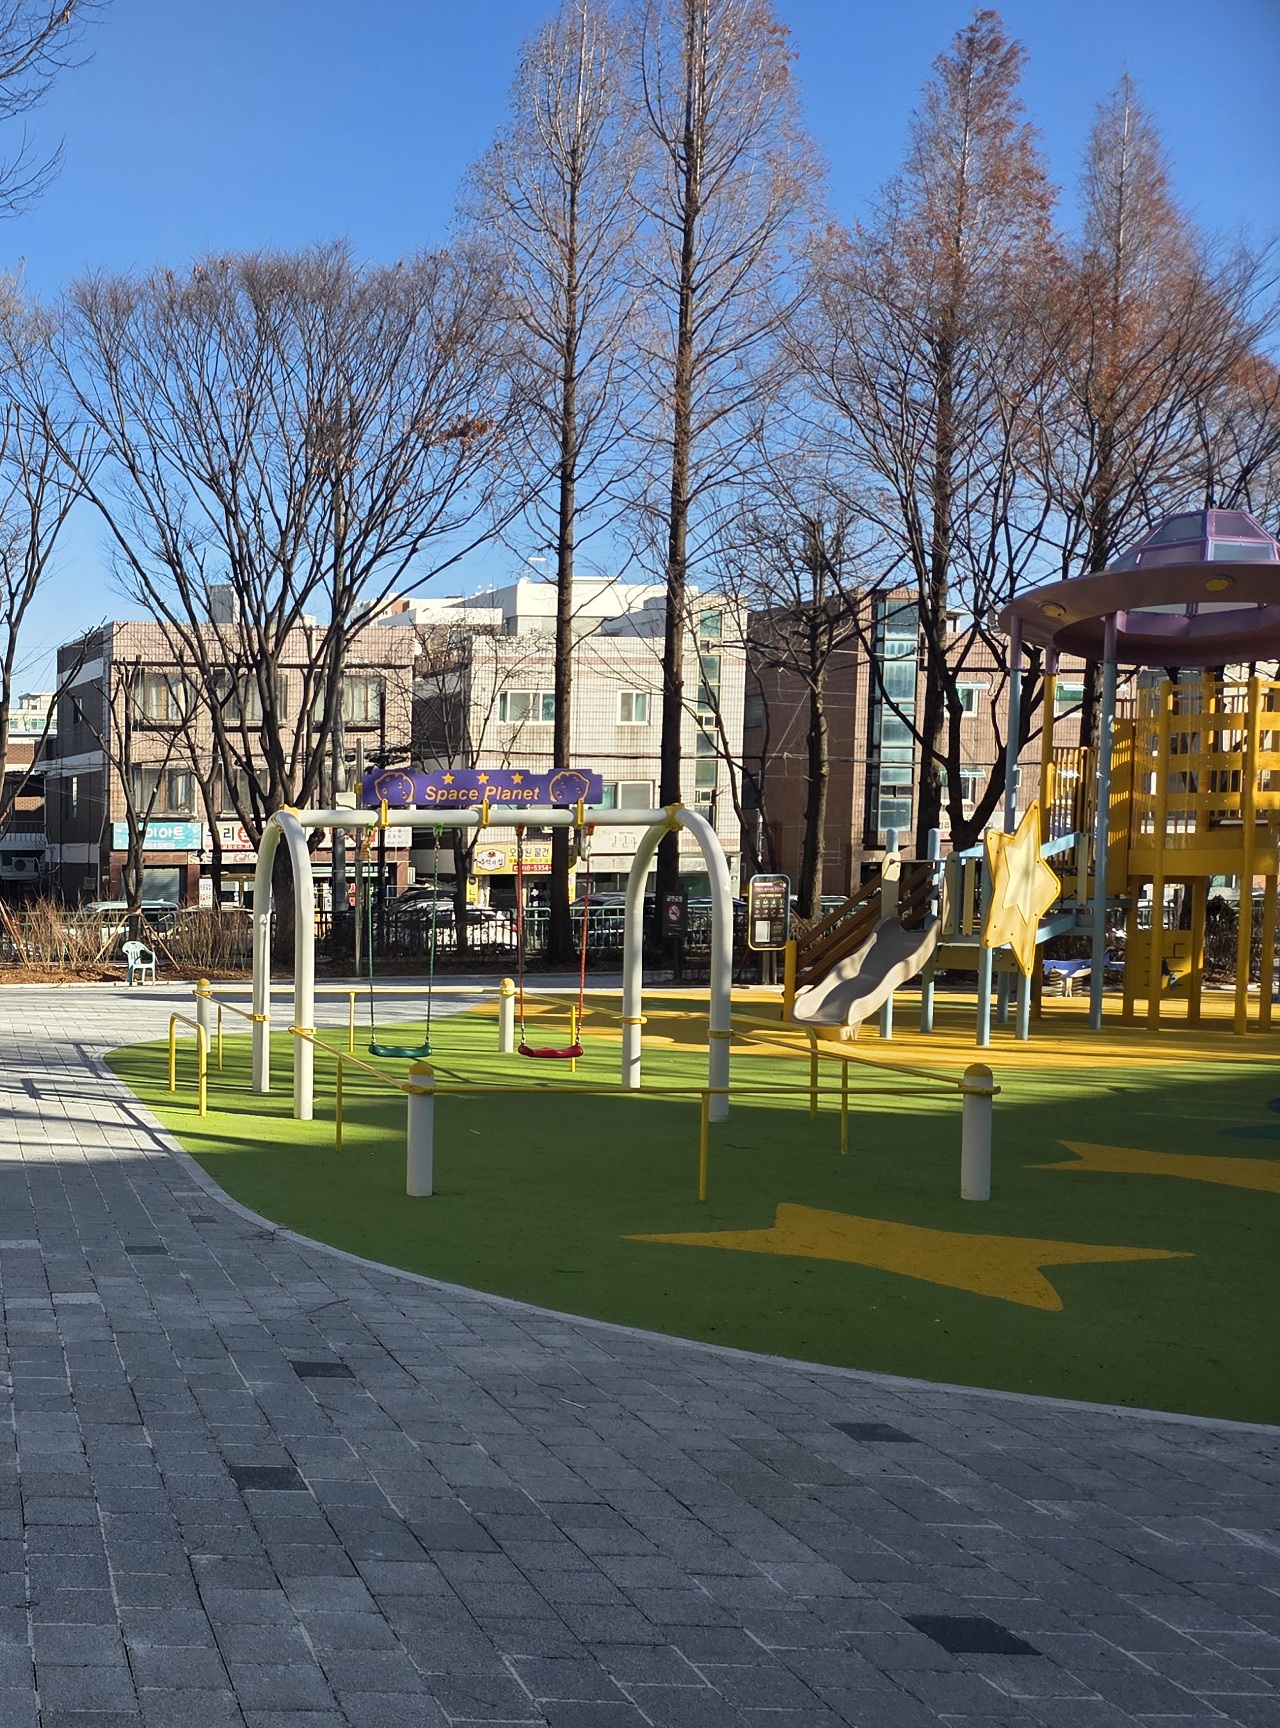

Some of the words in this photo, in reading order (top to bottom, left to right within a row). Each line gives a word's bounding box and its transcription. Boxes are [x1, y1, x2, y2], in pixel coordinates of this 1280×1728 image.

[425, 786, 480, 803] Space
[484, 786, 540, 801] Planet
[510, 848, 531, 857] 오된
